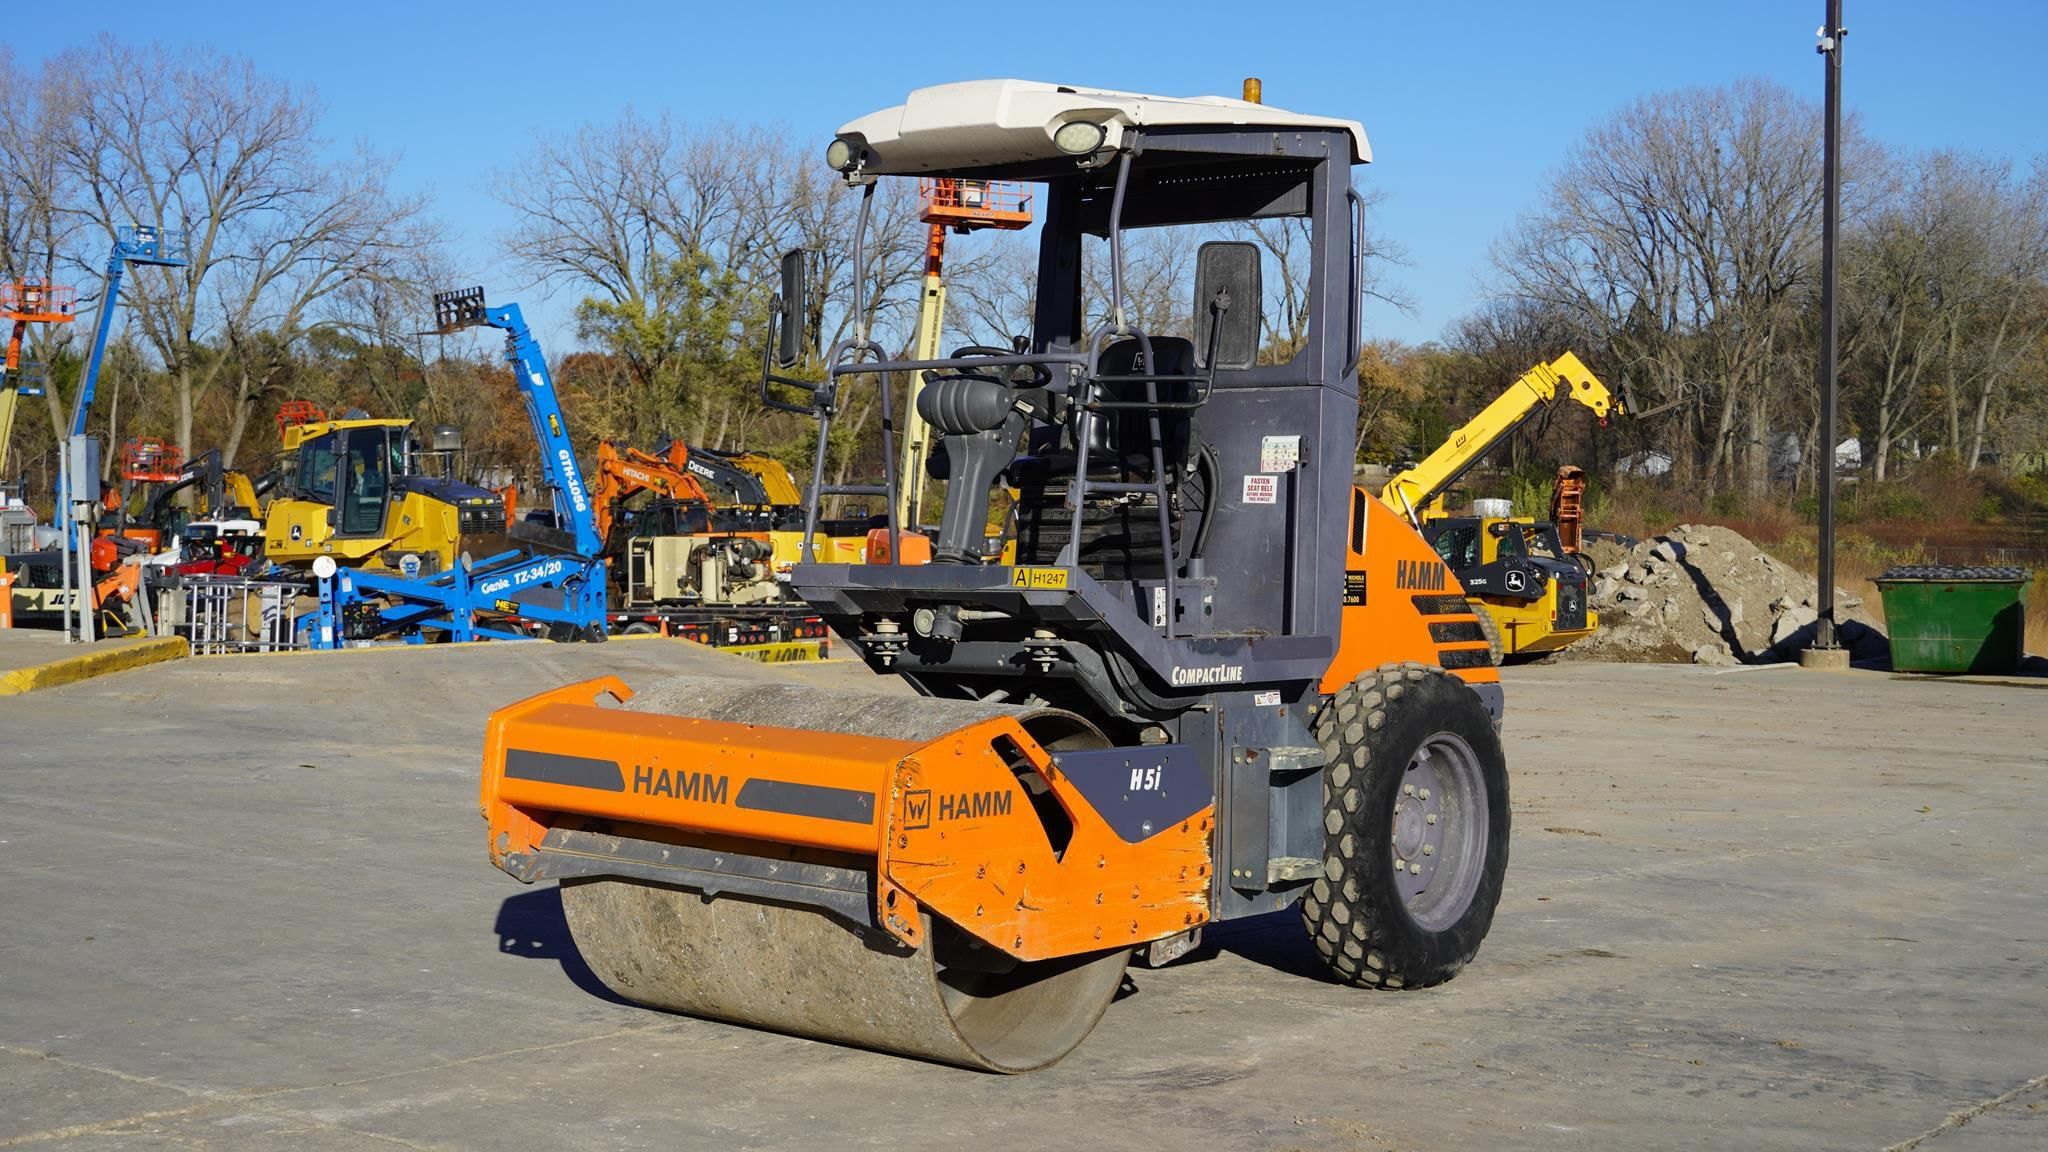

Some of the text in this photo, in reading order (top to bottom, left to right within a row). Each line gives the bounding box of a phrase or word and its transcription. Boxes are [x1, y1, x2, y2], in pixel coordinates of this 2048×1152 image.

[558, 449, 587, 512] GTH-1056
[622, 467, 650, 483] HITACHI
[687, 460, 716, 480] DEERE
[481, 560, 562, 595] Genie TZ-34/20
[1015, 569, 1065, 586] A H1247
[1396, 560, 1445, 591] HAMM
[632, 765, 729, 805] HAMM
[938, 790, 1012, 822] HAMM
